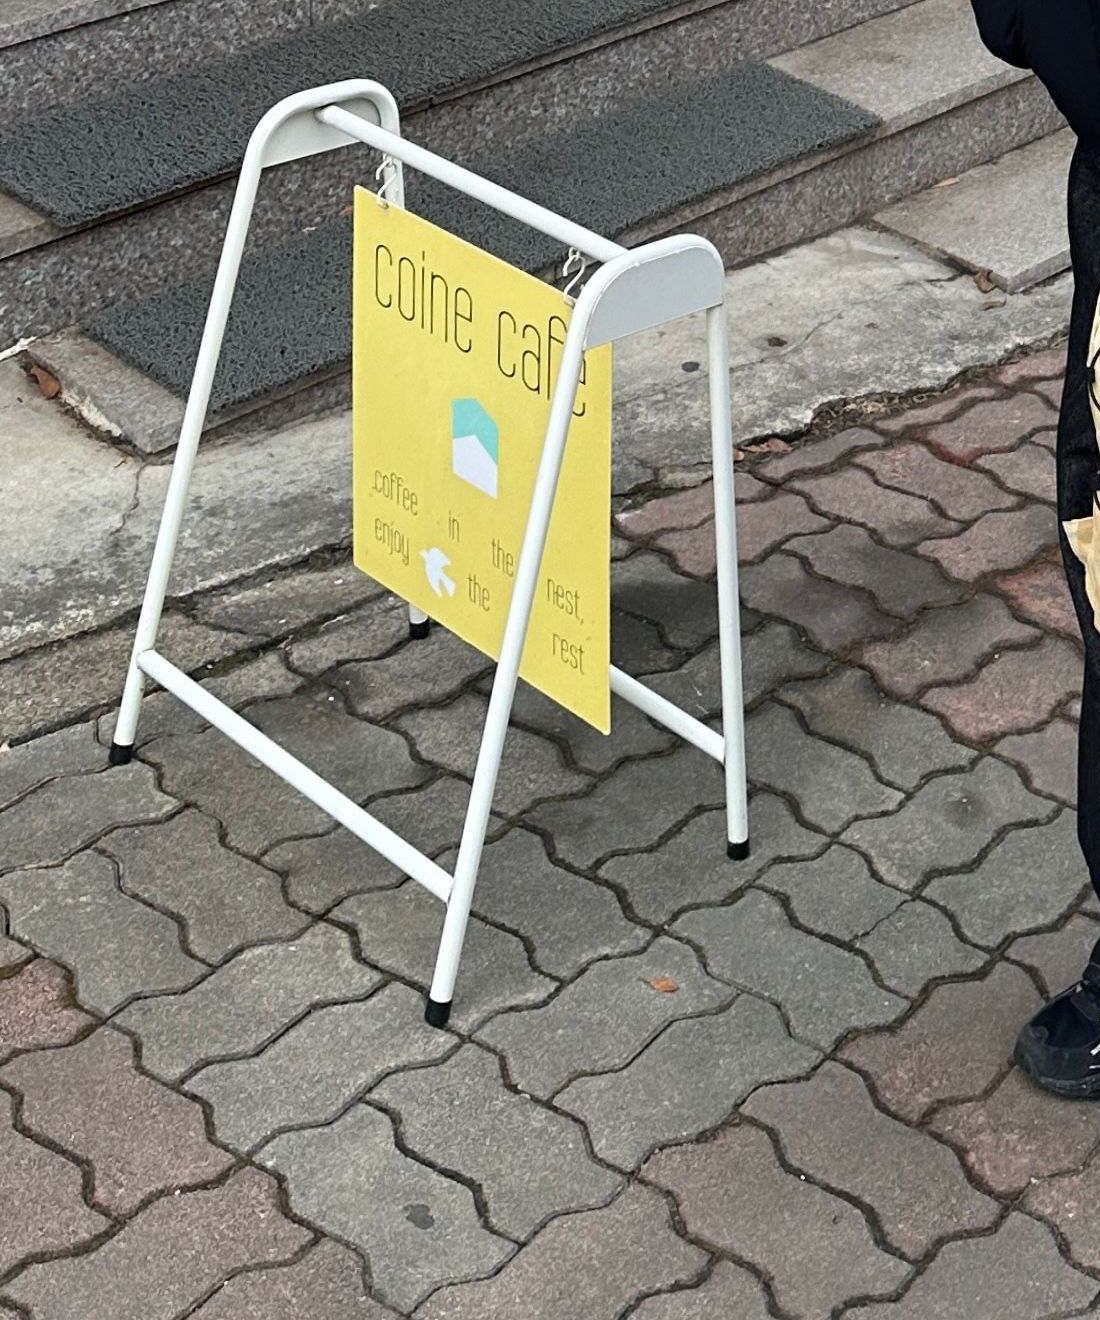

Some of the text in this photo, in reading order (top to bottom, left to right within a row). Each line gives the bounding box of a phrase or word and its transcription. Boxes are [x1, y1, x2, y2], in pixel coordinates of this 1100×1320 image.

[375, 244, 473, 353] coine
[374, 470, 585, 625] coffee in the nest,
[375, 518, 586, 675] enjoy the rest
